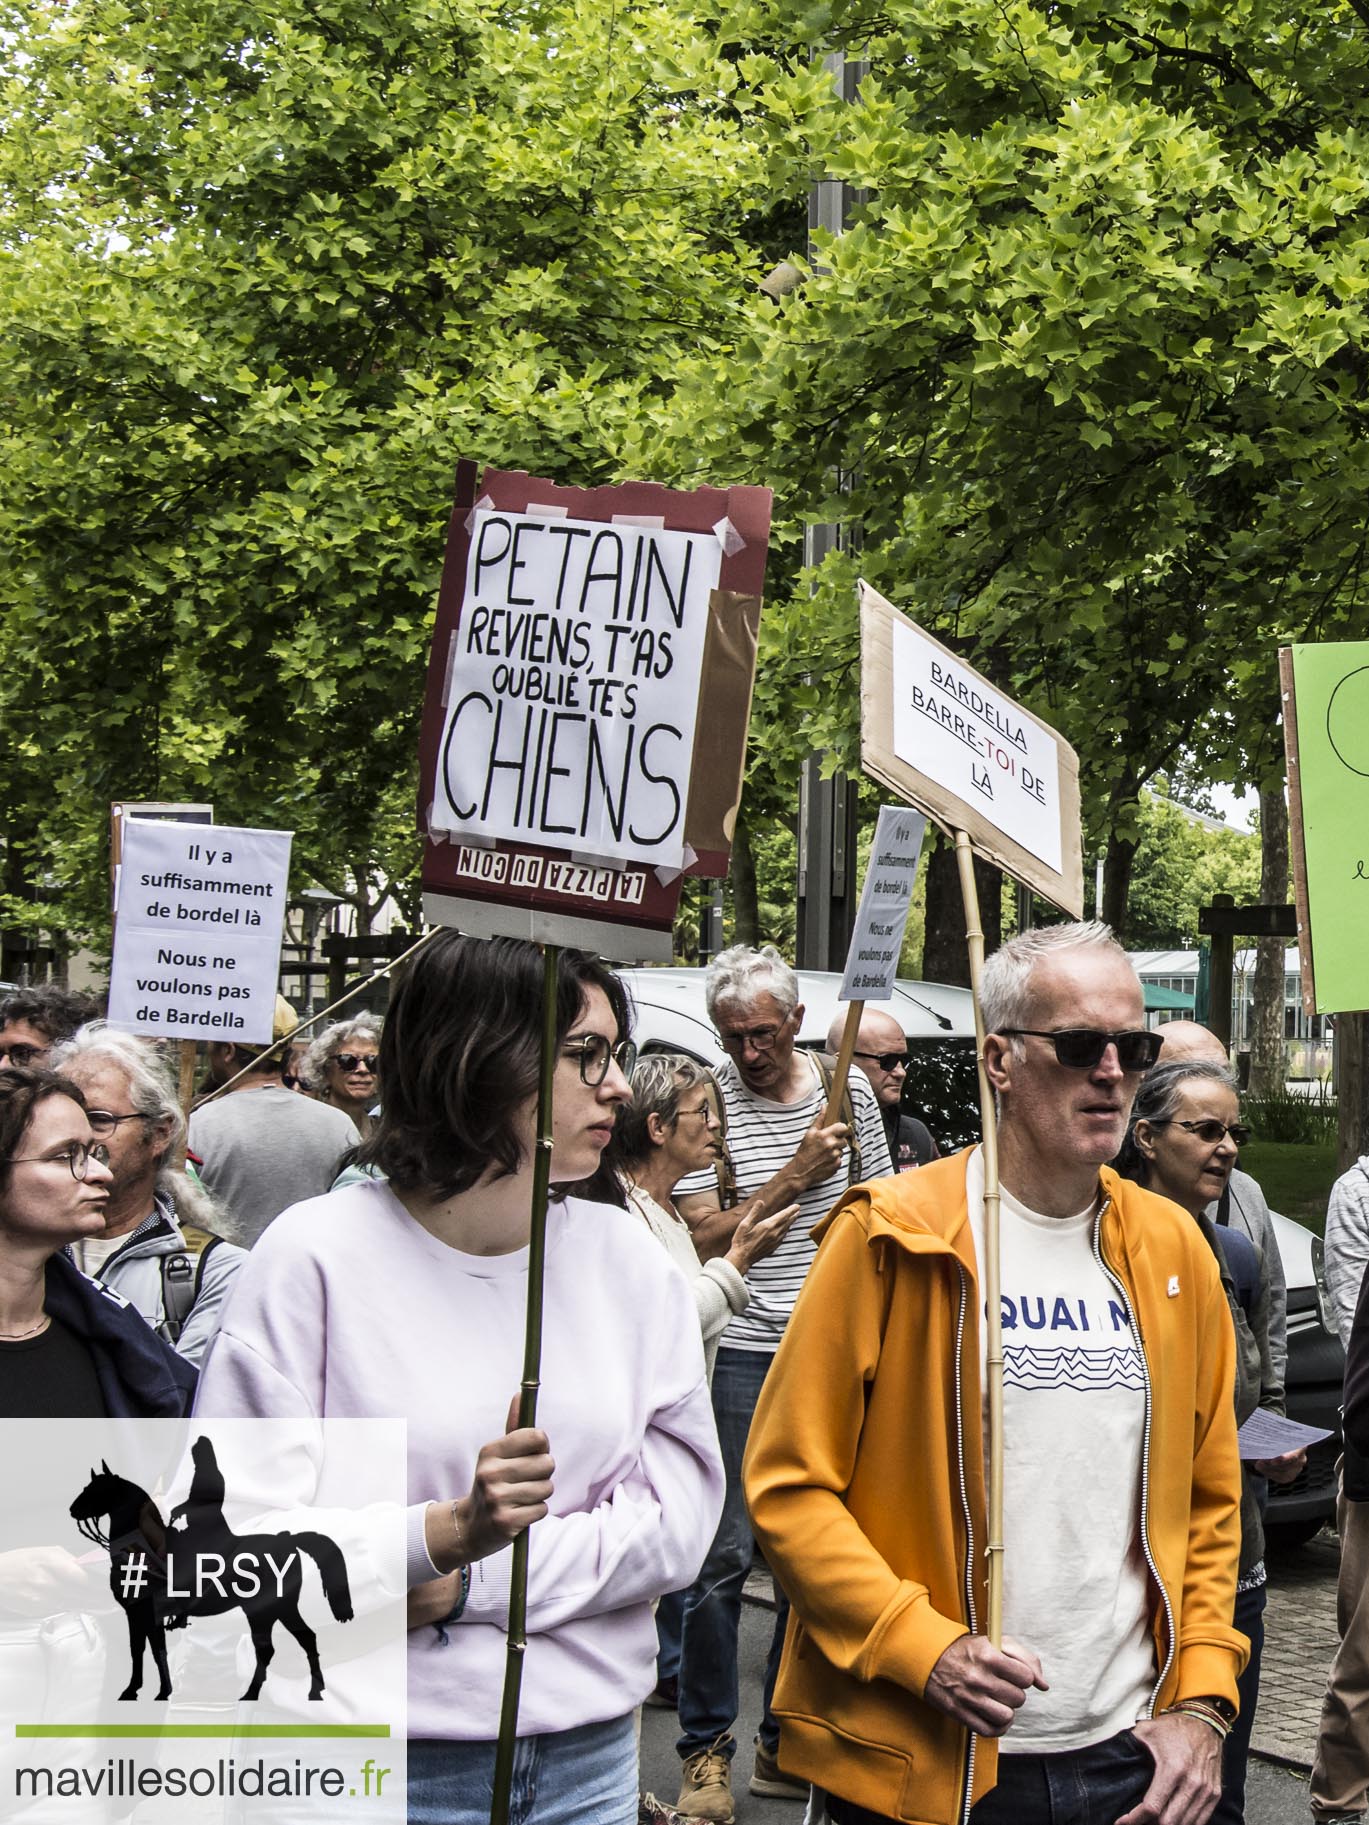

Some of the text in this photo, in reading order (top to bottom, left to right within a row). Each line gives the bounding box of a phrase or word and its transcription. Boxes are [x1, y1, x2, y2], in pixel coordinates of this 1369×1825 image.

[474, 517, 693, 628] PETAIN
[466, 606, 674, 679] REVIENS, T'AS
[492, 664, 639, 719] OUBLIÉ TES
[930, 660, 1028, 748] BARDELLA
[912, 685, 1046, 800] BARRE-TOI DE
[442, 691, 683, 846] CHIENS
[972, 762, 994, 796] LÀ
[188, 844, 232, 866] Il y a
[140, 873, 274, 897] suffisamment
[460, 847, 642, 900] LA PIZZA DU COIN
[874, 880, 883, 894] de
[882, 880, 902, 894] bordel
[147, 901, 261, 926] de bordel là
[869, 922, 893, 936] Nous ne
[157, 949, 236, 970] Nous ne
[858, 948, 893, 964] voulons pas
[136, 978, 251, 1001] voulons pas
[852, 974, 887, 988] de Bardella
[136, 1006, 245, 1029] de Bardella
[984, 1295, 1090, 1331] QUAI
